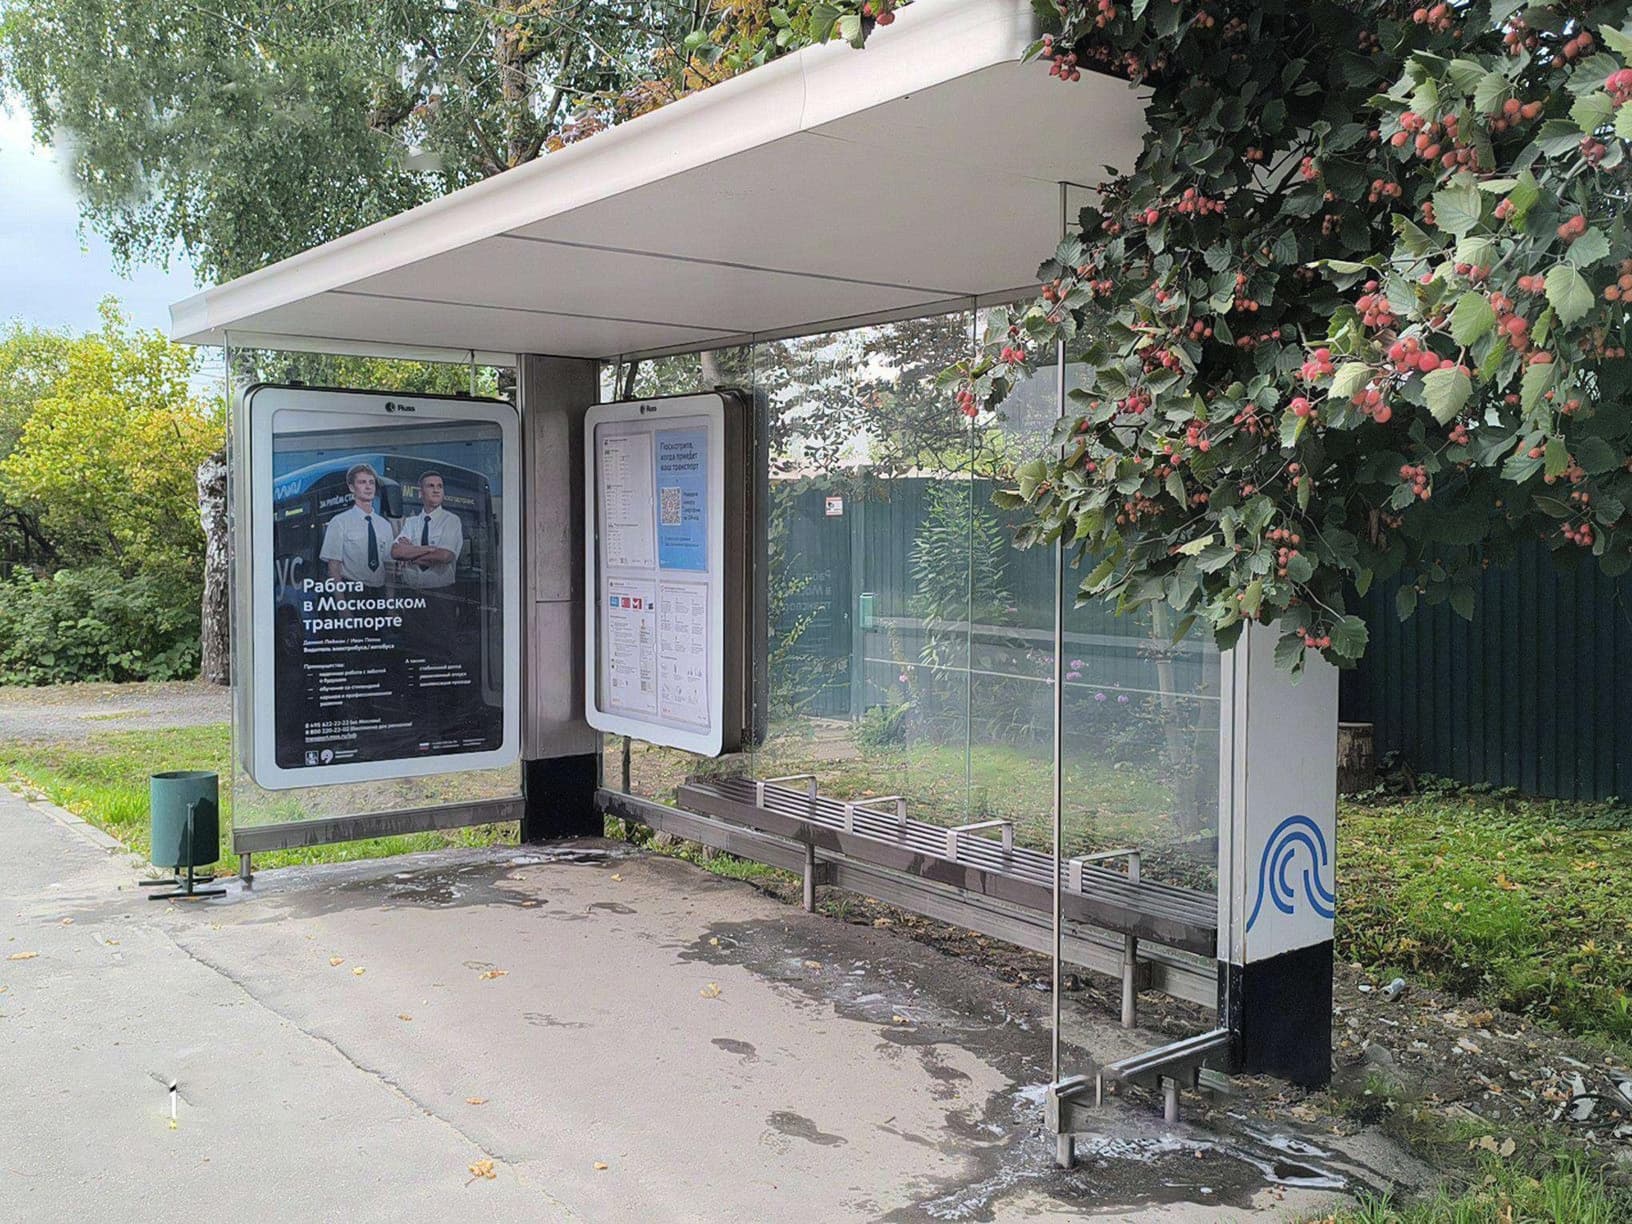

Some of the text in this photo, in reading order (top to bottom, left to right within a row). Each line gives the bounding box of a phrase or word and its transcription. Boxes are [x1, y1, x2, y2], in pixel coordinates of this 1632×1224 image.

[303, 578, 365, 594] Работа
[303, 595, 427, 613] в Московском
[303, 614, 403, 633] транспорте
